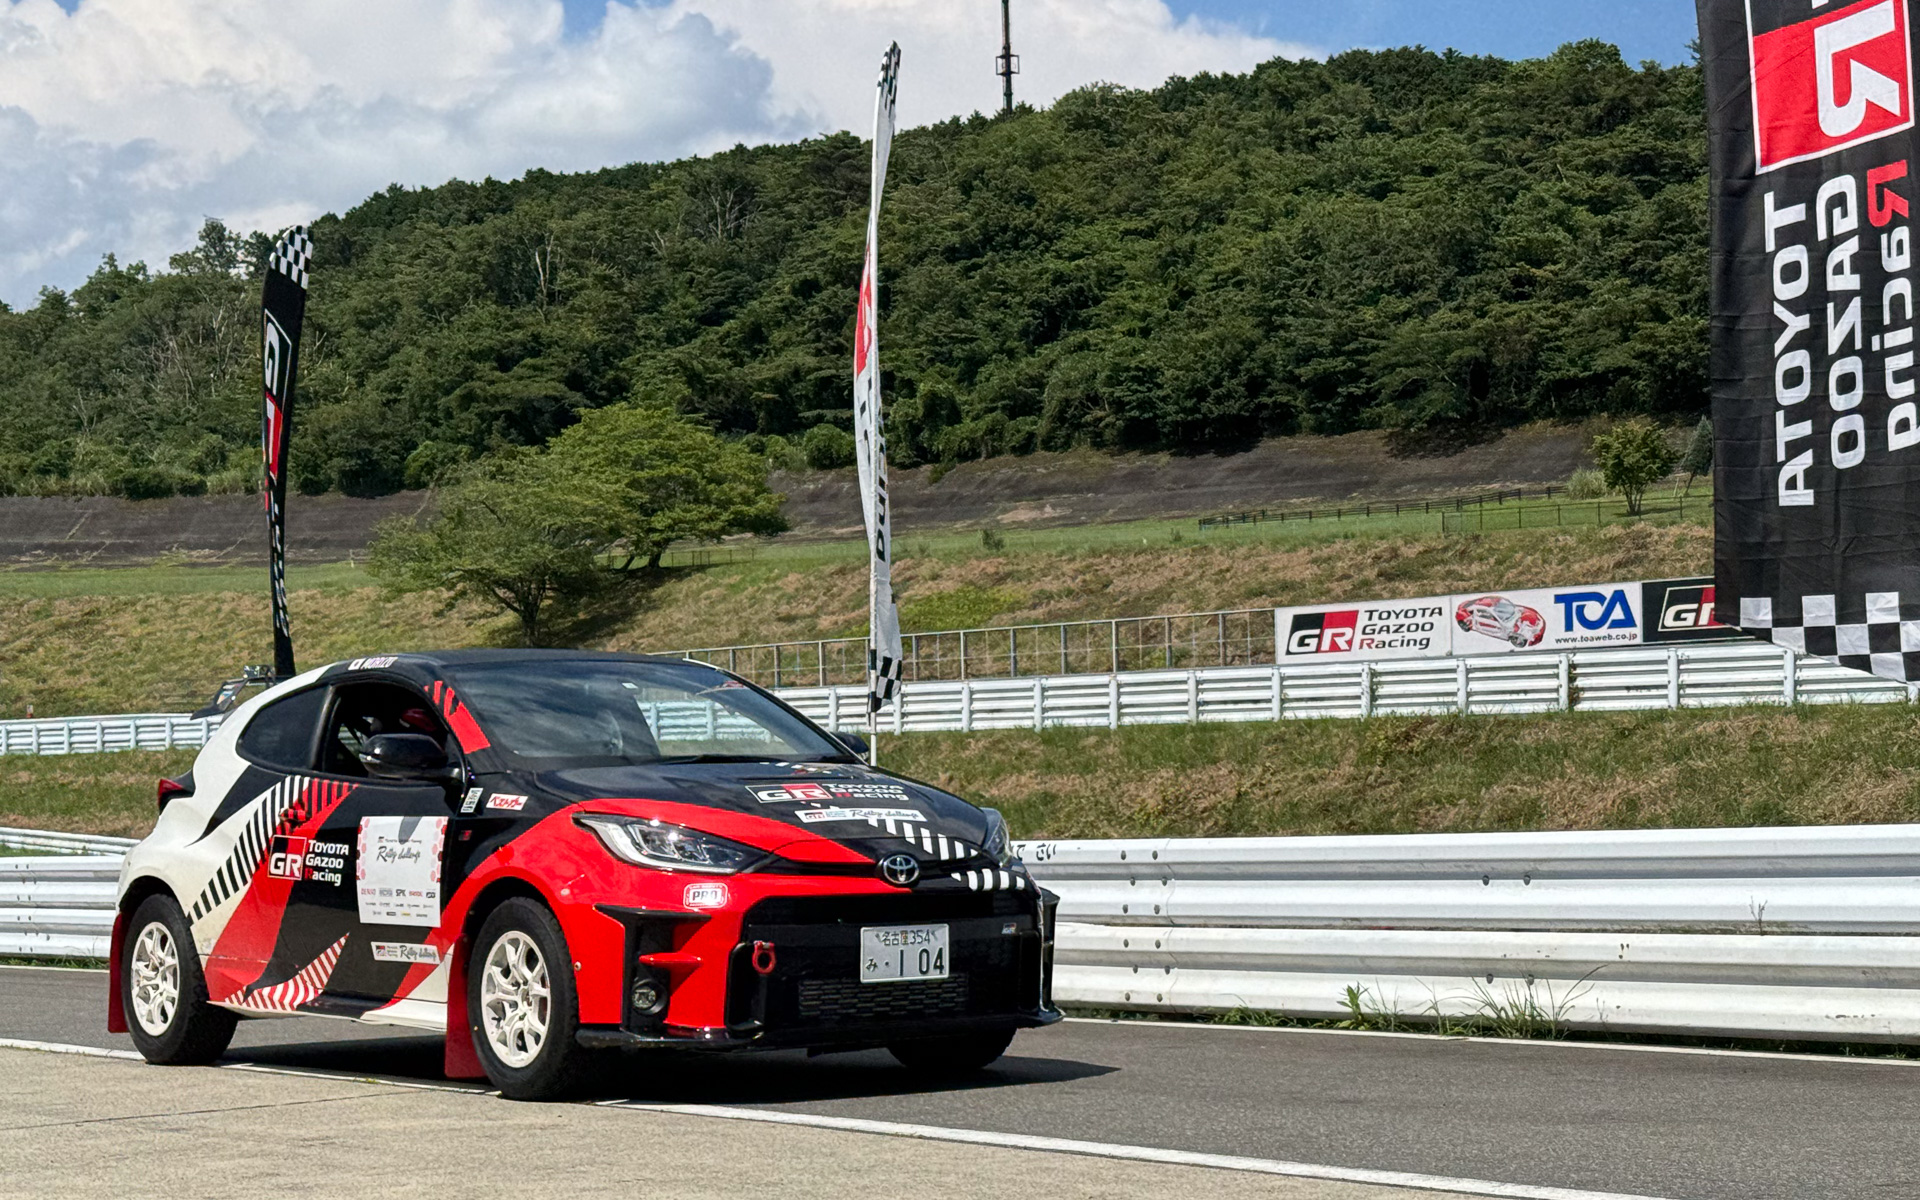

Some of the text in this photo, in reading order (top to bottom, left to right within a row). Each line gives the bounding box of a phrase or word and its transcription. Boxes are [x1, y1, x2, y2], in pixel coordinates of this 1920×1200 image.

[1364, 607, 1443, 622] TOYOTA
[1554, 589, 1637, 632] TOA
[1361, 622, 1434, 636] GAZOO
[1288, 626, 1354, 654] GR
[1359, 635, 1431, 650] Racing
[1555, 632, 1638, 645] www.toaweb.co.jp
[757, 788, 826, 802] GR
[308, 839, 349, 856] TOYOTA
[269, 852, 302, 878] GR
[305, 854, 344, 869] GAZOO
[304, 867, 342, 887] Racing
[692, 890, 718, 901] PRO
